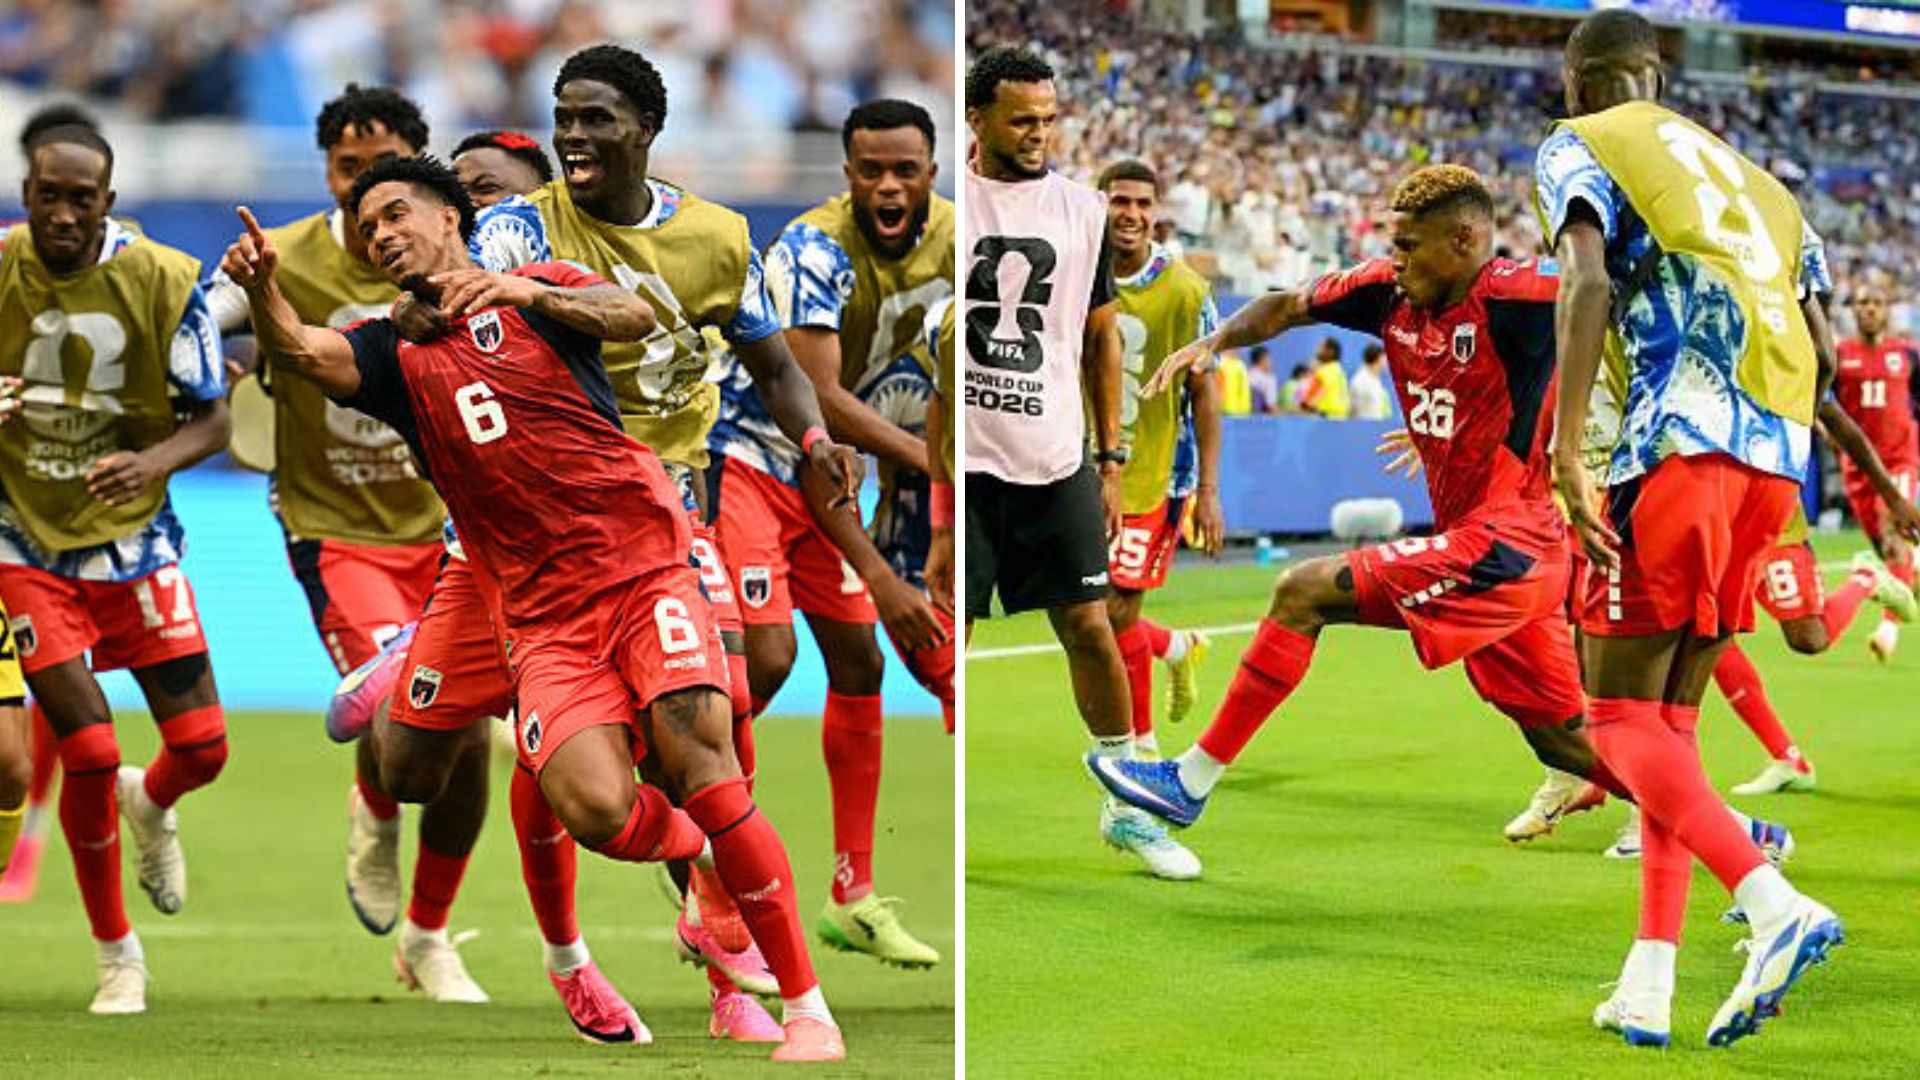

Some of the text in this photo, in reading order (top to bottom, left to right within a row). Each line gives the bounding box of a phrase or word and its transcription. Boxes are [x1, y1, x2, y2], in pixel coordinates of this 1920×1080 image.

[987, 341, 1025, 361] FIFA
[965, 386, 1044, 416] 2026
[1018, 379, 1044, 392] CUP
[1860, 380, 1888, 408] 11
[455, 381, 508, 445] 6
[1407, 381, 1457, 438] 26
[133, 565, 195, 629] 17
[654, 597, 700, 653] 6
